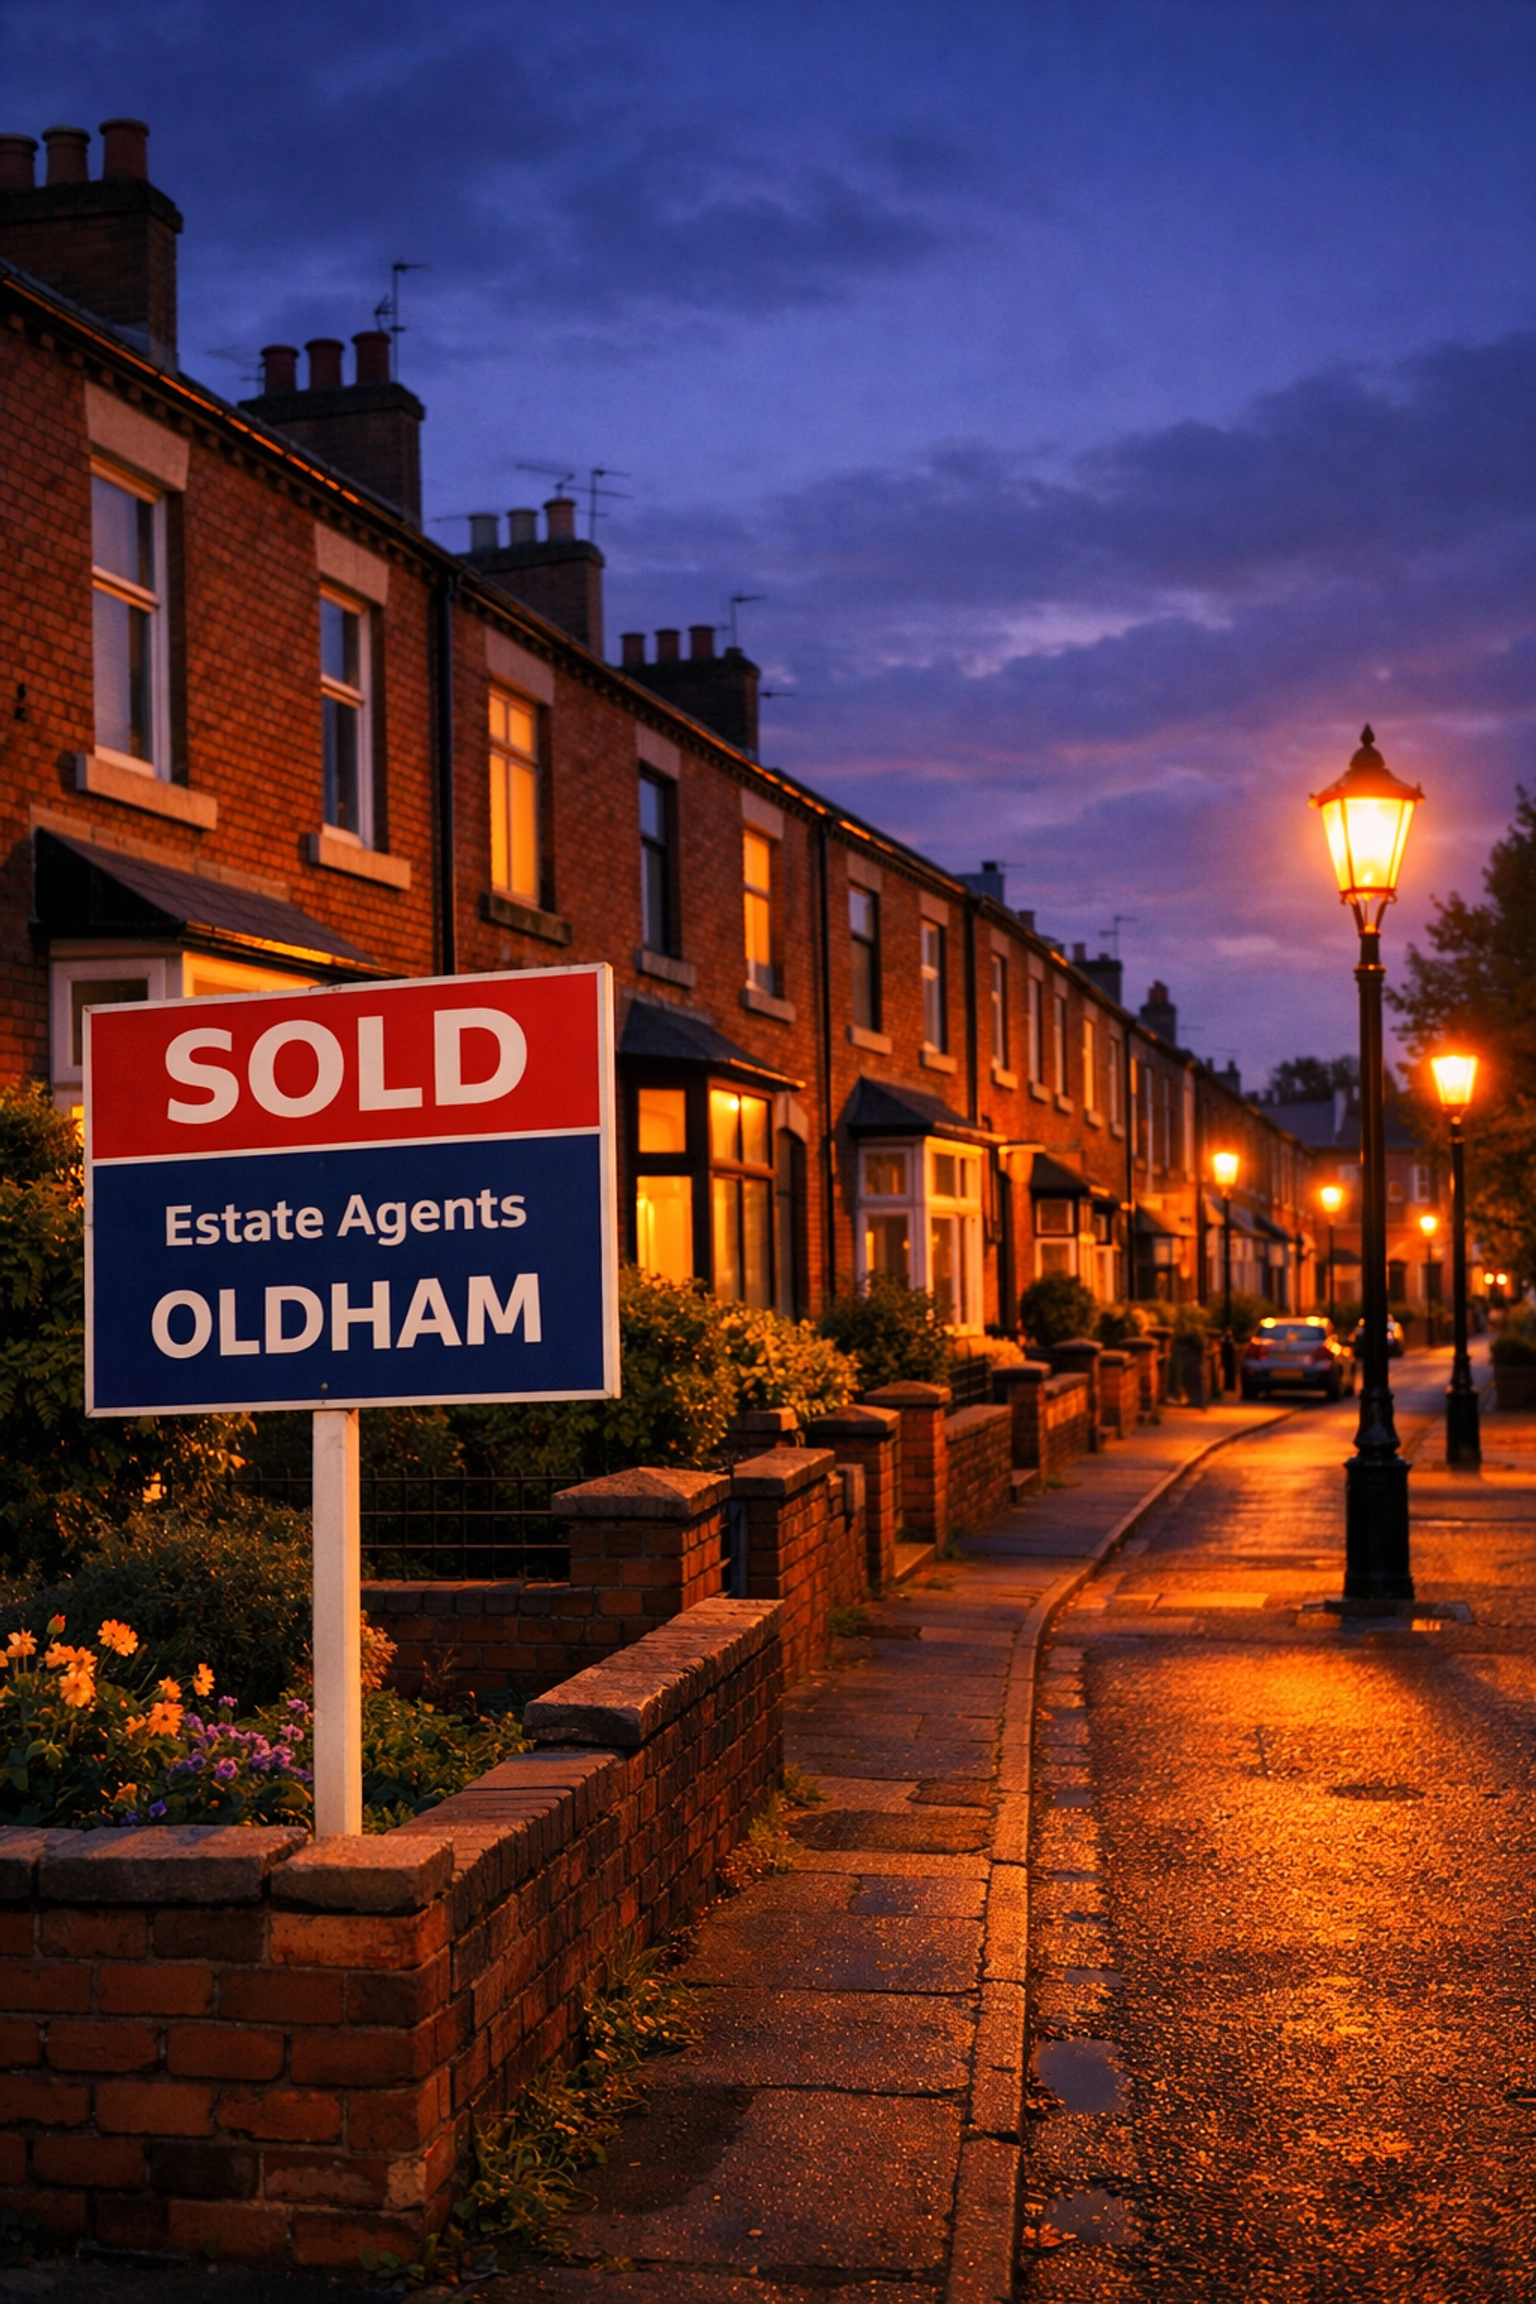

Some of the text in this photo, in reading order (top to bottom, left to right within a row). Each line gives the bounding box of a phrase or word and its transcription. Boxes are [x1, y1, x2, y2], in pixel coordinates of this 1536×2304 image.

[165, 1007, 528, 1125] SOLD
[166, 1188, 527, 1247] Estate Agents
[151, 1272, 542, 1359] OLDHAM
